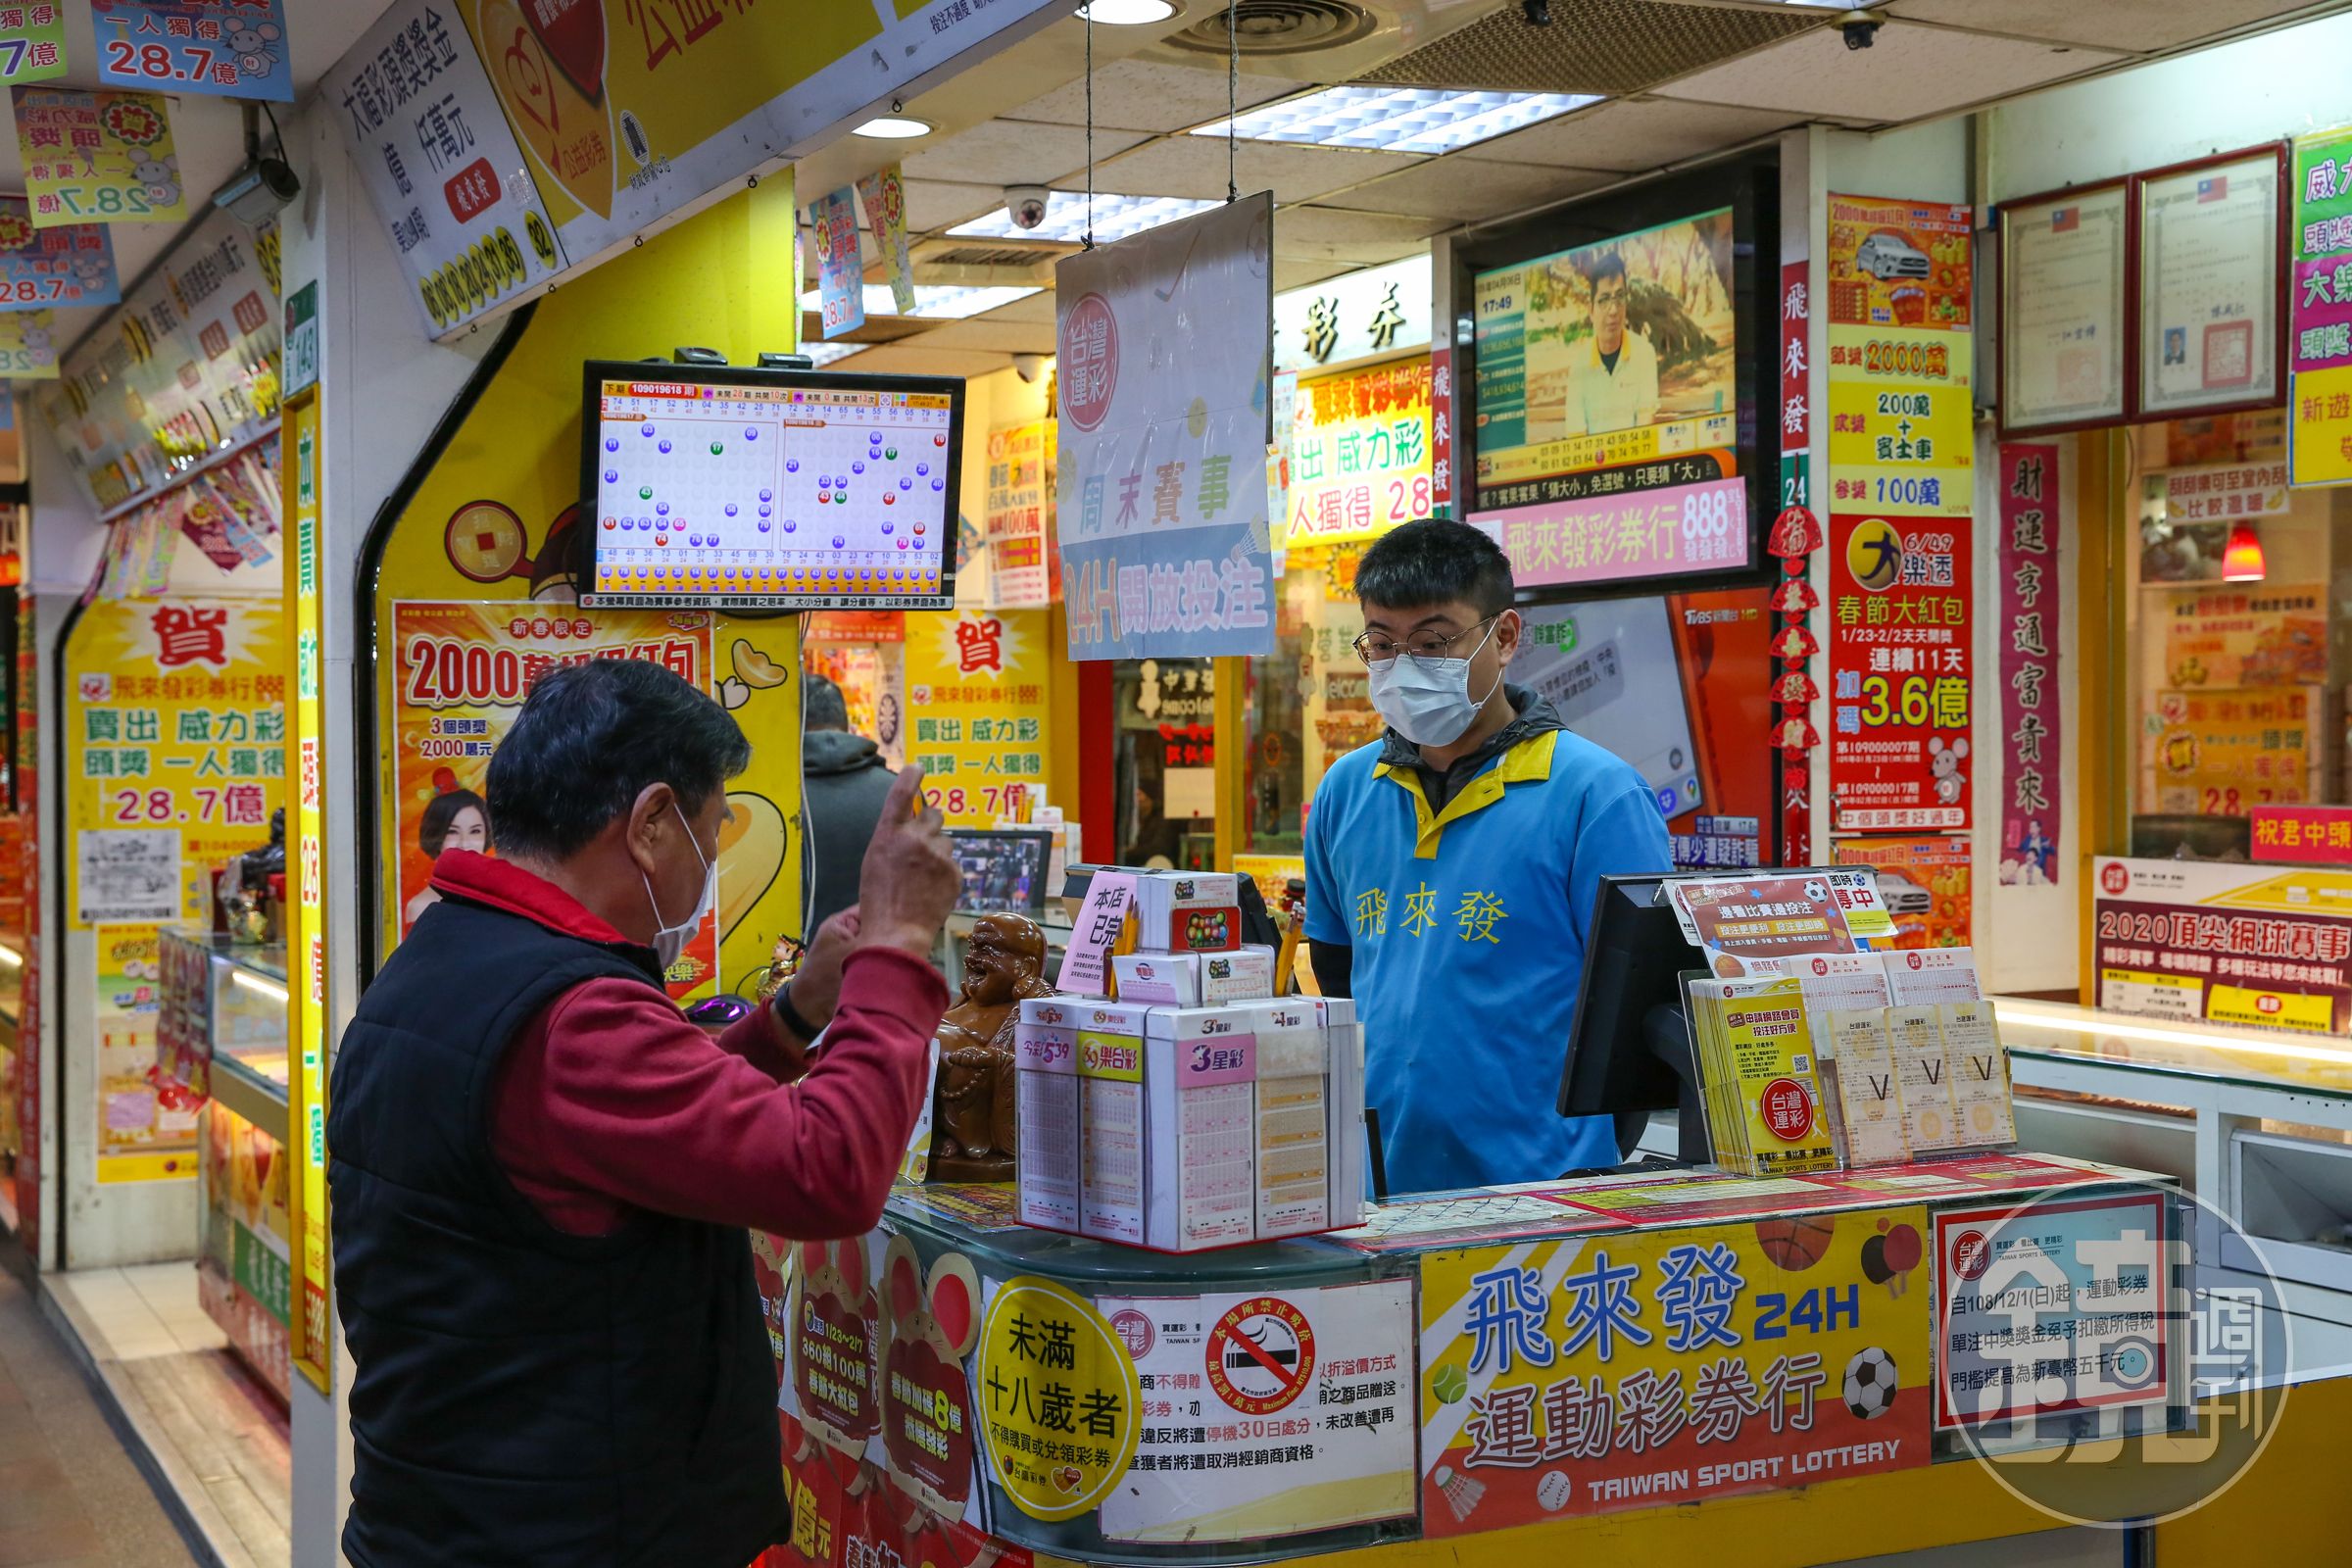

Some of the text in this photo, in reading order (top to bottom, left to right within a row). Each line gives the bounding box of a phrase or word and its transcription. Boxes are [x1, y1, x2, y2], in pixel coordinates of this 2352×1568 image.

[105, 15, 220, 40] 一人獨得
[930, 4, 971, 34] 投注不過度
[108, 41, 239, 86] 28.7億
[343, 6, 458, 142] 大福彩頭獎獎金
[414, 93, 475, 174] 仟萬元
[527, 220, 551, 259] 32
[1483, 296, 1512, 313] 17:49
[1069, 318, 1109, 365] 台灣
[1783, 281, 1808, 435] 飛來發
[1865, 341, 1949, 379] 2000萬
[1069, 365, 1108, 408] 運彩
[1877, 393, 1931, 417] 200萬
[1433, 364, 1450, 492] 飛來發
[1337, 419, 1423, 474] 威力彩
[1080, 454, 1233, 535] 周末賽事
[1291, 476, 1431, 537] 人獨得 28
[1785, 476, 1806, 506] 24
[1876, 477, 1941, 507] 100萬
[1507, 489, 1728, 574] 飛來發彩券行 888
[1904, 534, 1952, 551] 6/49
[1065, 558, 1268, 644] 24H開放投注
[1685, 609, 1712, 625] TVBS
[1836, 594, 1965, 626] 春節大紅包
[151, 605, 228, 667] 賀
[512, 618, 591, 638] 新春限定
[2012, 454, 2050, 816] 財運亨通富貴來
[955, 618, 1002, 672] 賀
[1869, 647, 1965, 673] 連續11天
[116, 675, 249, 702] 飛來發彩券行
[1836, 668, 1861, 735] 加碼
[1860, 674, 1969, 730] 3.6億
[84, 709, 285, 743] 賣出 威力彩
[431, 717, 487, 734] 3個頭獎
[917, 718, 1040, 743] 賣出 威力彩
[964, 755, 1041, 775] 一人獨得
[116, 785, 266, 825] 28.7億
[1840, 811, 1961, 827] 中個頭獎好過年
[2256, 819, 2352, 848] 祝君中頭
[1095, 887, 1126, 909] 本店
[1355, 881, 1509, 945] 飛來發
[1718, 901, 1815, 919] 邊看比賽邊投注
[1720, 919, 1825, 936] 投注更便利 投注更即時
[2100, 910, 2351, 963] 2020頂尖網球賽事
[1745, 1008, 1800, 1024] 申請網路會員
[1753, 1023, 1797, 1037] 投注好方便
[1023, 1034, 1070, 1063] 今彩539
[1190, 1044, 1245, 1073] 3星彩
[1771, 1092, 1802, 1110] 台灣
[1774, 1109, 1805, 1130] 運彩
[1762, 1161, 1834, 1175] TAIWAN SPORTS LOTTERY
[1959, 1240, 1984, 1256] 台灣
[1959, 1255, 1984, 1272] 運彩
[2019, 1250, 2038, 1260] SPORTS
[1463, 1242, 1860, 1375] 飛來發 24H
[1009, 1313, 1076, 1370] 未滿
[802, 1337, 867, 1389] 360組100萬
[808, 1368, 859, 1417] 春節大紅包
[987, 1364, 1122, 1439] 十八歲者
[1261, 1396, 1289, 1411] Maximum
[1463, 1351, 1827, 1470] 運動彩券行
[991, 1422, 1110, 1468] 不得購買或兌領彩券
[1588, 1439, 1900, 1502] TAIWAN SPORT LOTTERY
